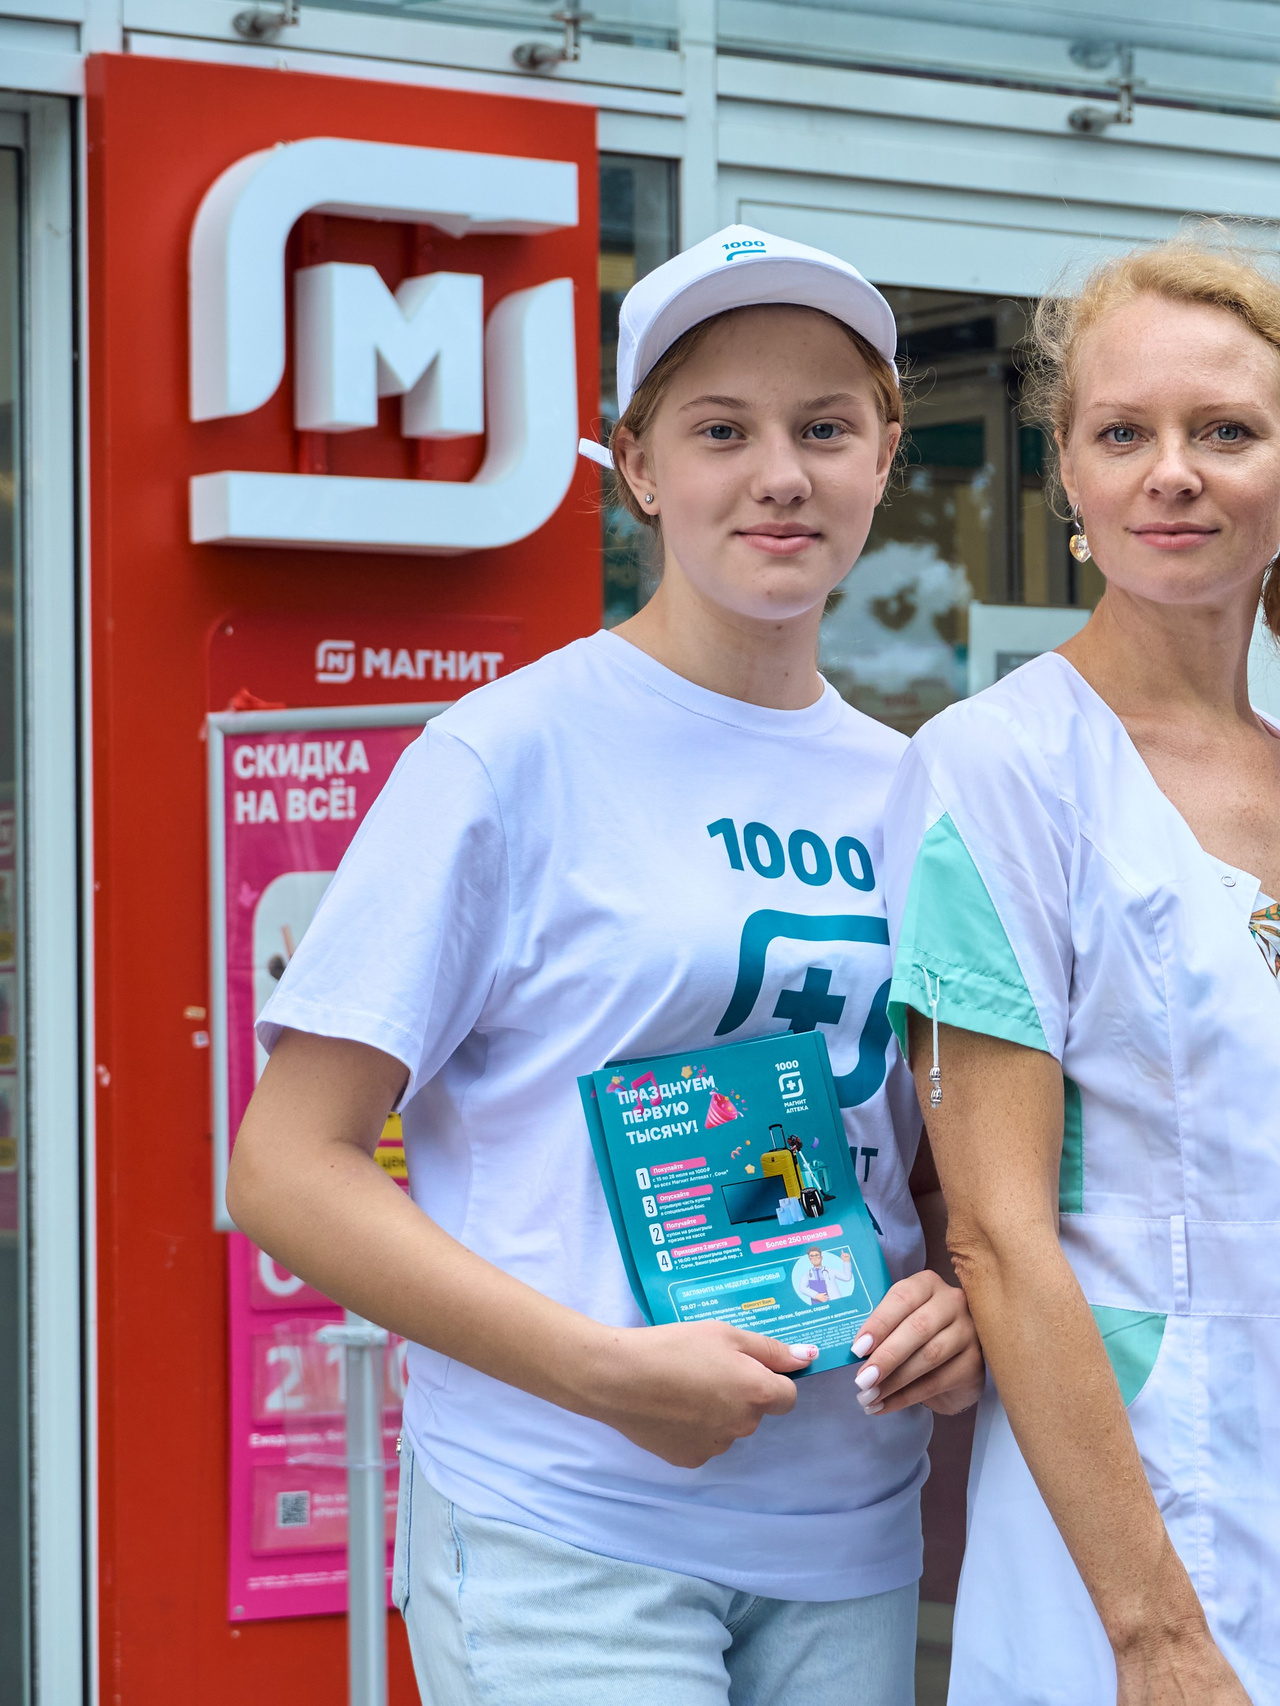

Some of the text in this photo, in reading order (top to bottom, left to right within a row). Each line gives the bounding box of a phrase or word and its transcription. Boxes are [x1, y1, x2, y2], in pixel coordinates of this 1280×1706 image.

[722, 241, 765, 250] 1000
[363, 647, 504, 681] МАГНИТ
[233, 740, 370, 781] СКИДКА
[234, 778, 356, 824] НА ВСЁ!
[707, 817, 876, 892] 1000
[775, 1060, 799, 1071] 1000
[618, 1075, 715, 1105] ПРАЗДНУЕМ
[622, 1102, 689, 1125] ПЕРВУЮ
[784, 1099, 806, 1107] МАГНИТ
[786, 1105, 809, 1114] АПТЕКА
[626, 1120, 699, 1145] ТЫСЯЧУ!
[653, 1164, 683, 1174] Покупайте
[646, 1192, 689, 1214] 3 Опускайте
[653, 1219, 696, 1242] 2 Получайте
[765, 1230, 827, 1249] Более 250 призов
[660, 1254, 668, 1268] 4
[673, 1246, 703, 1256] Приходите
[707, 1241, 727, 1249] августа
[681, 1286, 715, 1297] ЗАГЛЯНИТЕ
[724, 1279, 749, 1288] НЕДЕЛЮ
[749, 1272, 780, 1283] ЗДОРОВЬЯ
